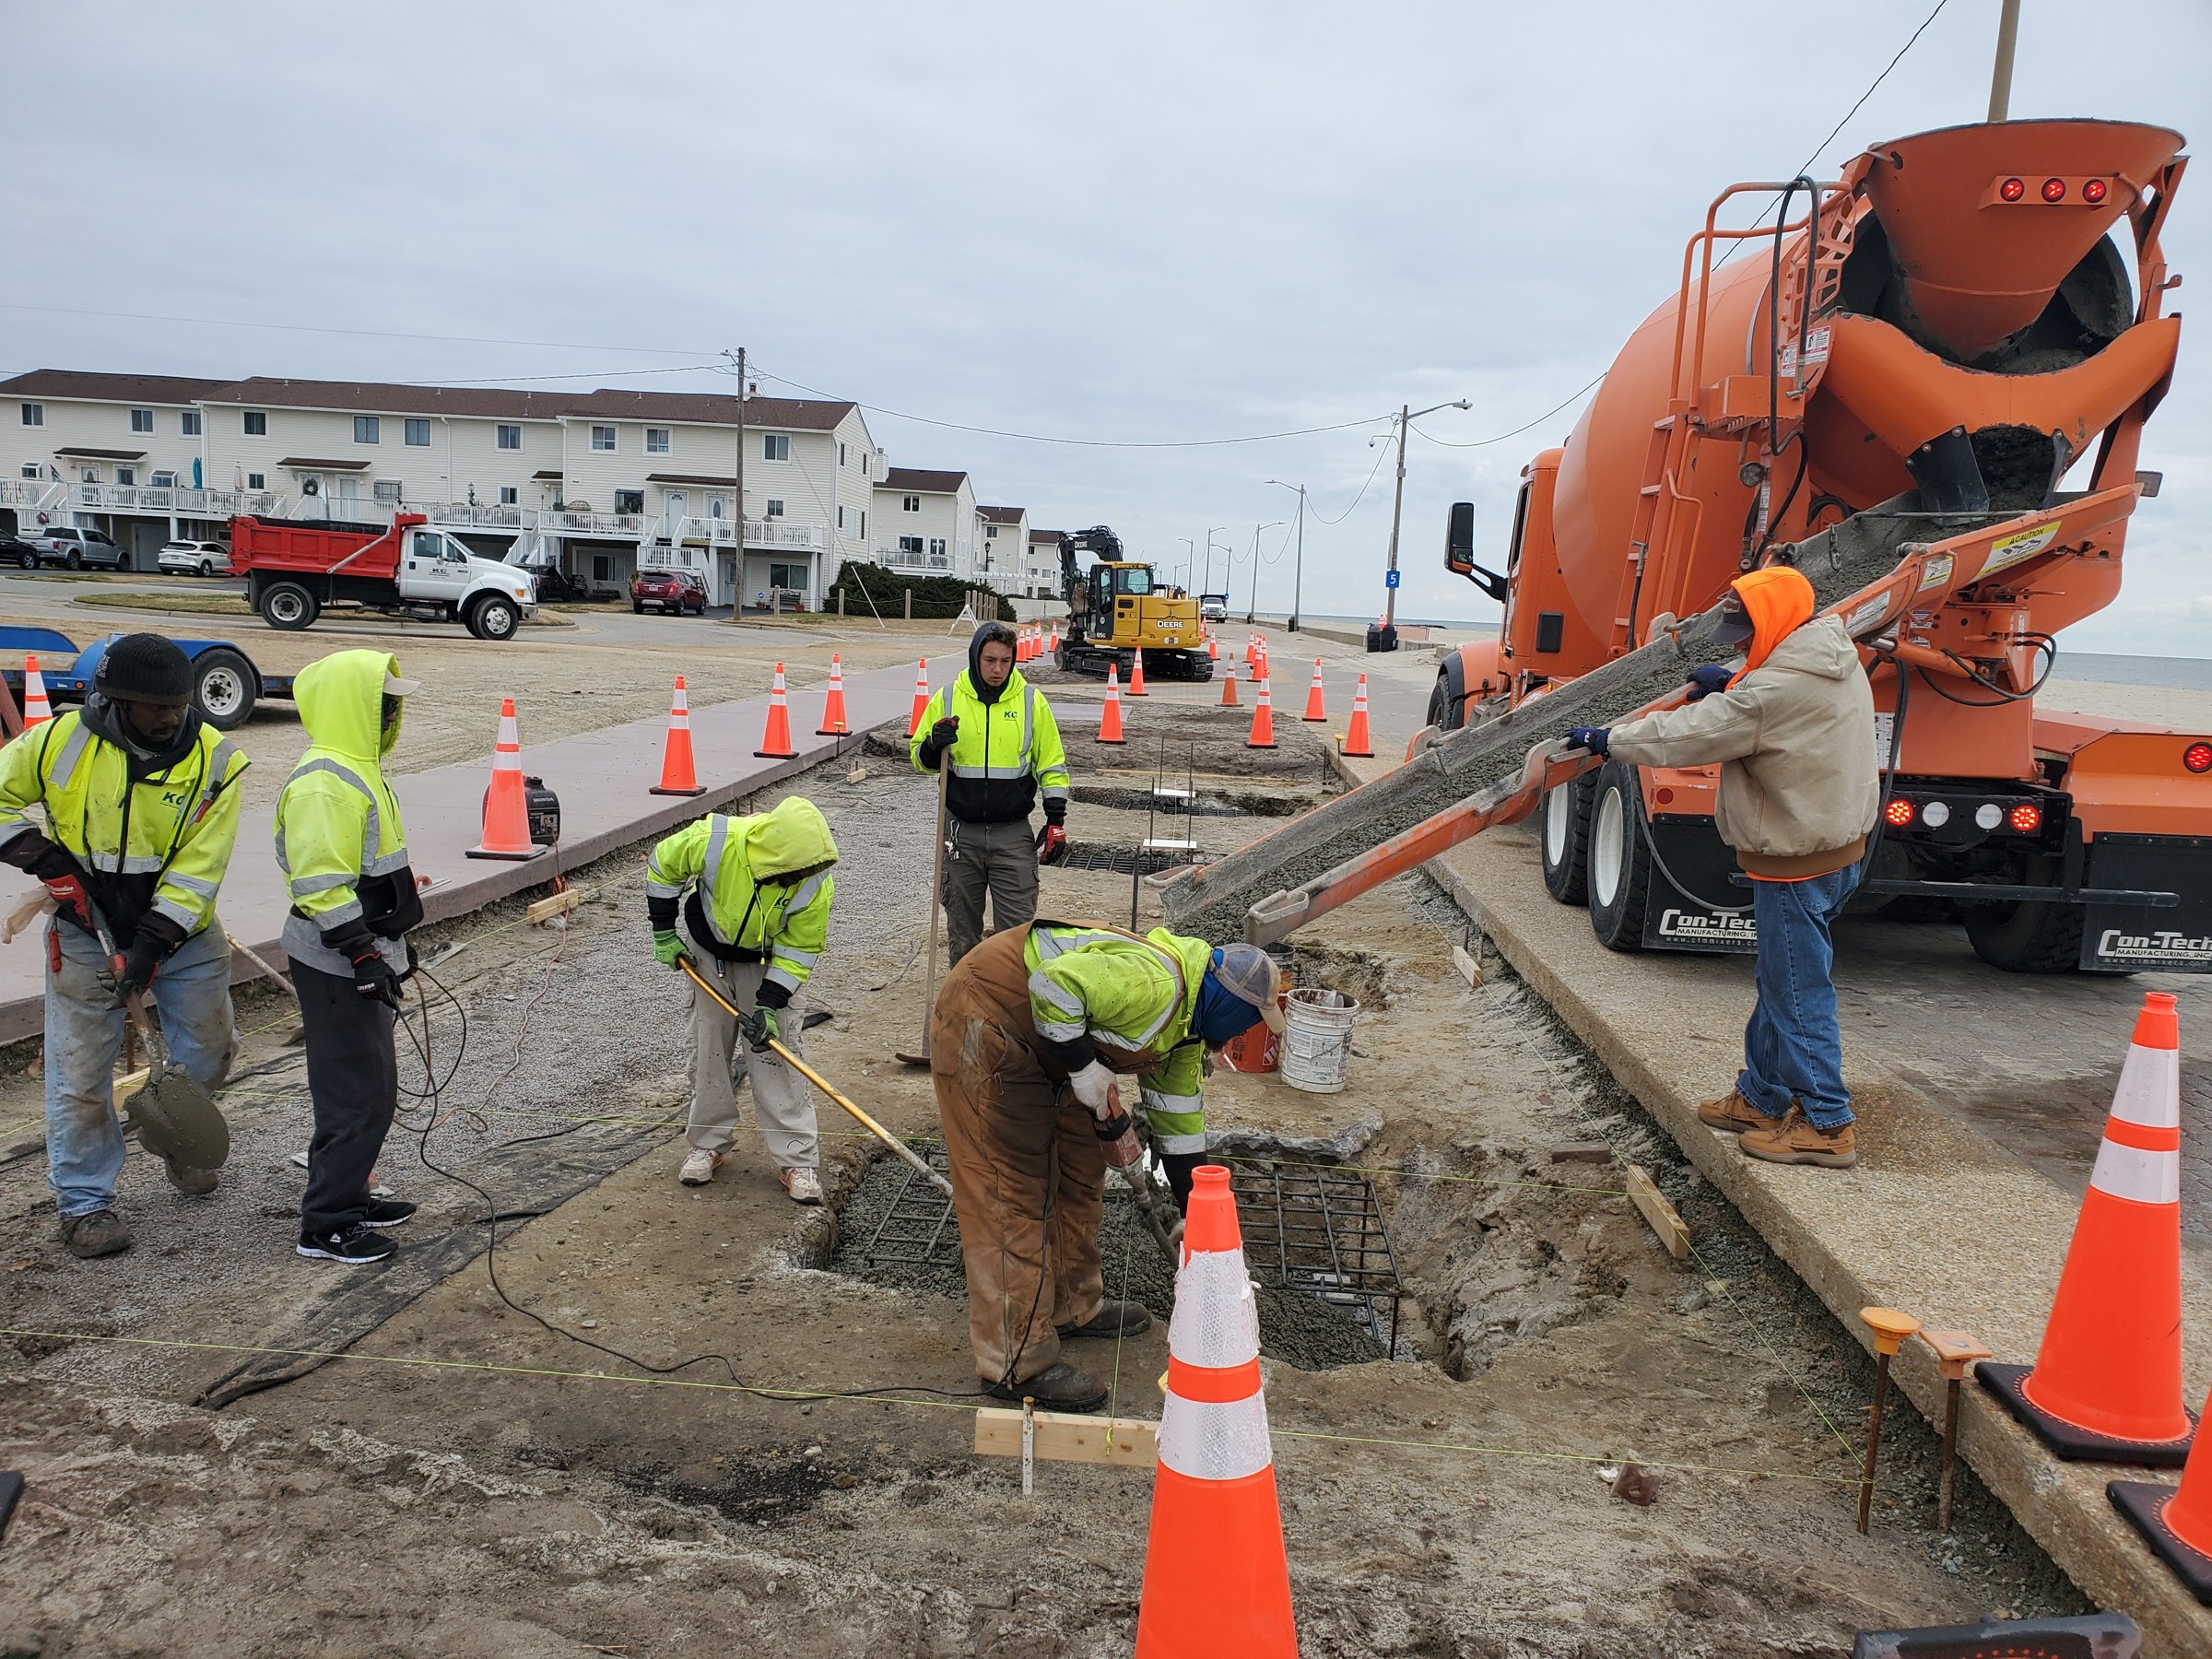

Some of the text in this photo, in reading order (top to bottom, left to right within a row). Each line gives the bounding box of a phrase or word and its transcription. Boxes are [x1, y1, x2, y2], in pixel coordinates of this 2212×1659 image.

[2016, 528, 2045, 544] CAUTION
[1390, 574, 1396, 584] 5
[1157, 620, 1184, 629] DEERE
[1659, 909, 1757, 935] Con-Tec
[1677, 928, 1749, 938] MANUFACTURING,
[1665, 936, 1758, 947] www.ctmmixers.co
[2098, 929, 2212, 957] Con-Tech
[2117, 948, 2192, 958] MANUFACTURING,
